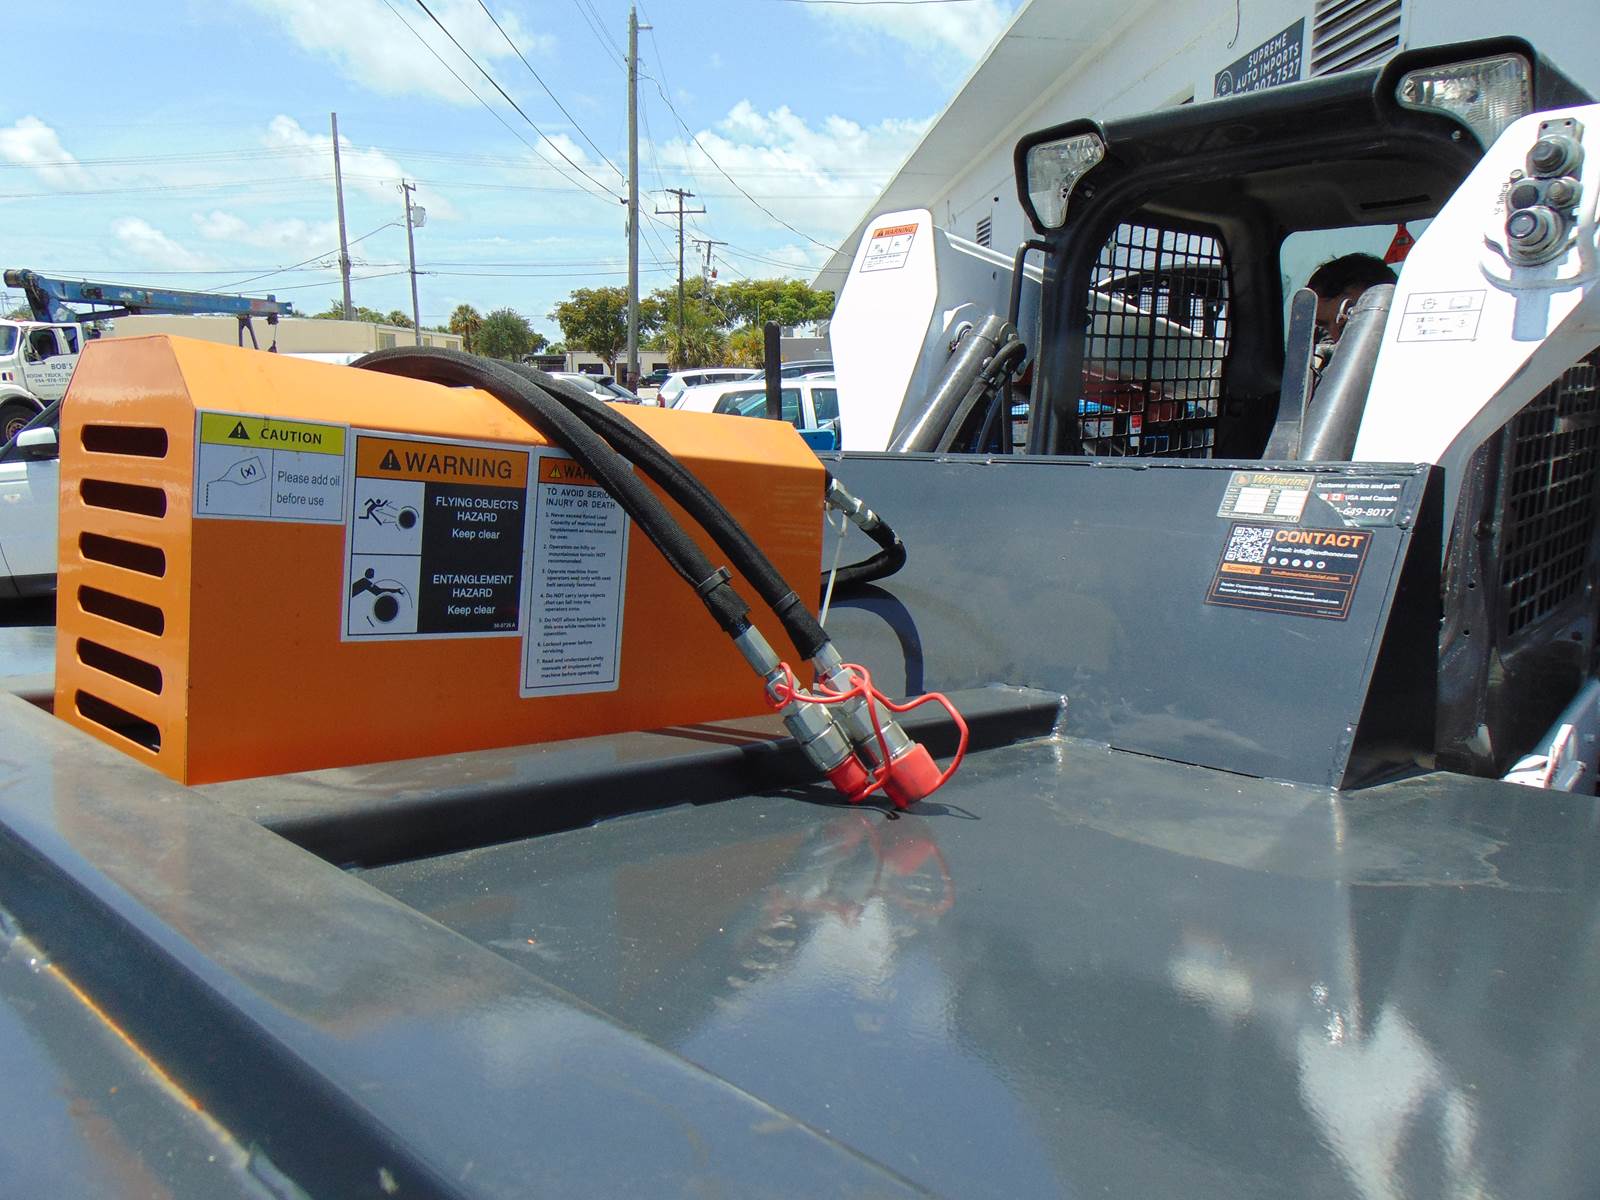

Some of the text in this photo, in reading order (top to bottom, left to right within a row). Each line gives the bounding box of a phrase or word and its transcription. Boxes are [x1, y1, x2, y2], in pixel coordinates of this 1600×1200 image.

[1248, 32, 1287, 68] SUPREME
[1236, 42, 1299, 91] AUTO IMPORTS
[884, 226, 914, 236] WARNING
[260, 428, 322, 444] CAUTION
[405, 452, 512, 479] WARNING
[278, 470, 340, 486] Please add oil
[1253, 474, 1309, 486] Wolverine
[276, 492, 324, 506] before use
[561, 489, 584, 497] AVOID
[435, 496, 519, 510] FLYING OBJECTS
[546, 498, 573, 507] INJURY
[592, 501, 615, 509] DEATH
[457, 511, 497, 522] HAZARD
[452, 528, 500, 541] Keep clear
[1276, 530, 1364, 548] CONTACT
[433, 574, 513, 584] ENTANGLEMENT
[452, 588, 493, 598] HAZARD
[448, 605, 495, 616] Keep clear
